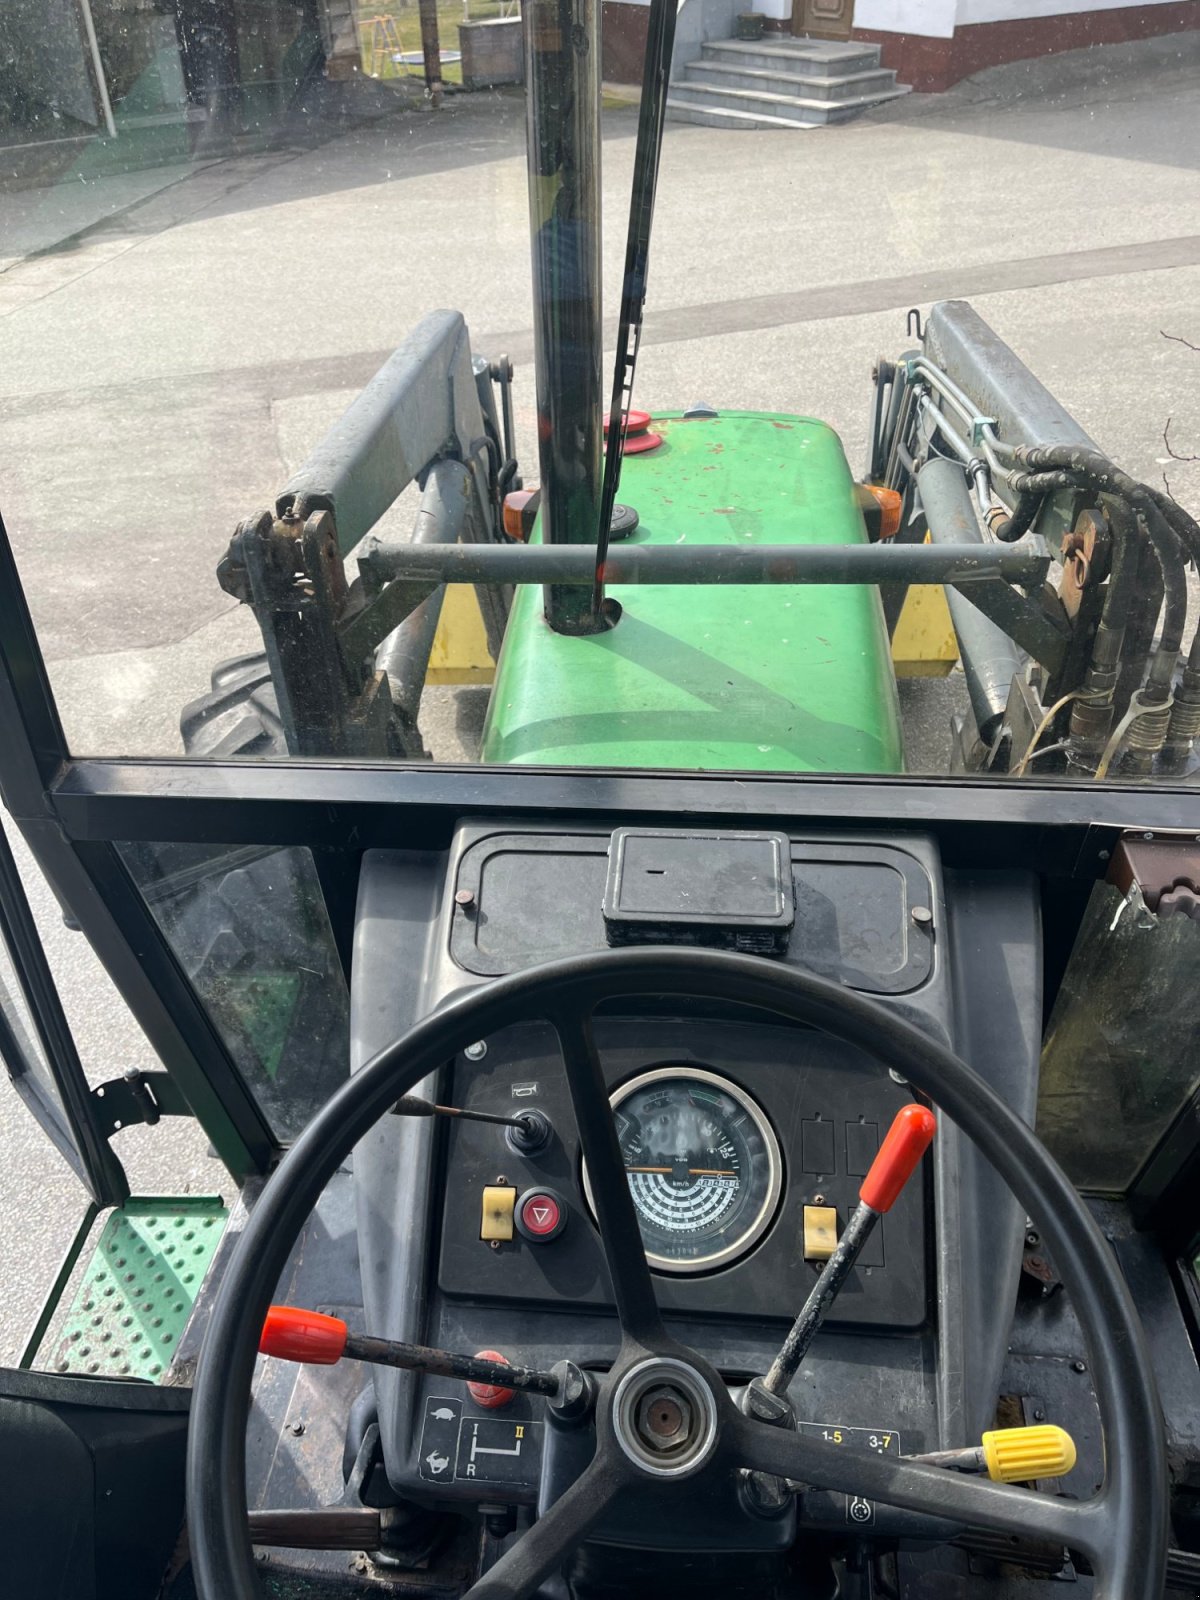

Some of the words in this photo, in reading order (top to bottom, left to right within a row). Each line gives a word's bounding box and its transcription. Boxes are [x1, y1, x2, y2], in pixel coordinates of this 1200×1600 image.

[720, 1148, 730, 1159] 25
[822, 1430, 842, 1444] 1-5
[869, 1436, 892, 1448] 3-7
[466, 1464, 476, 1476] R
